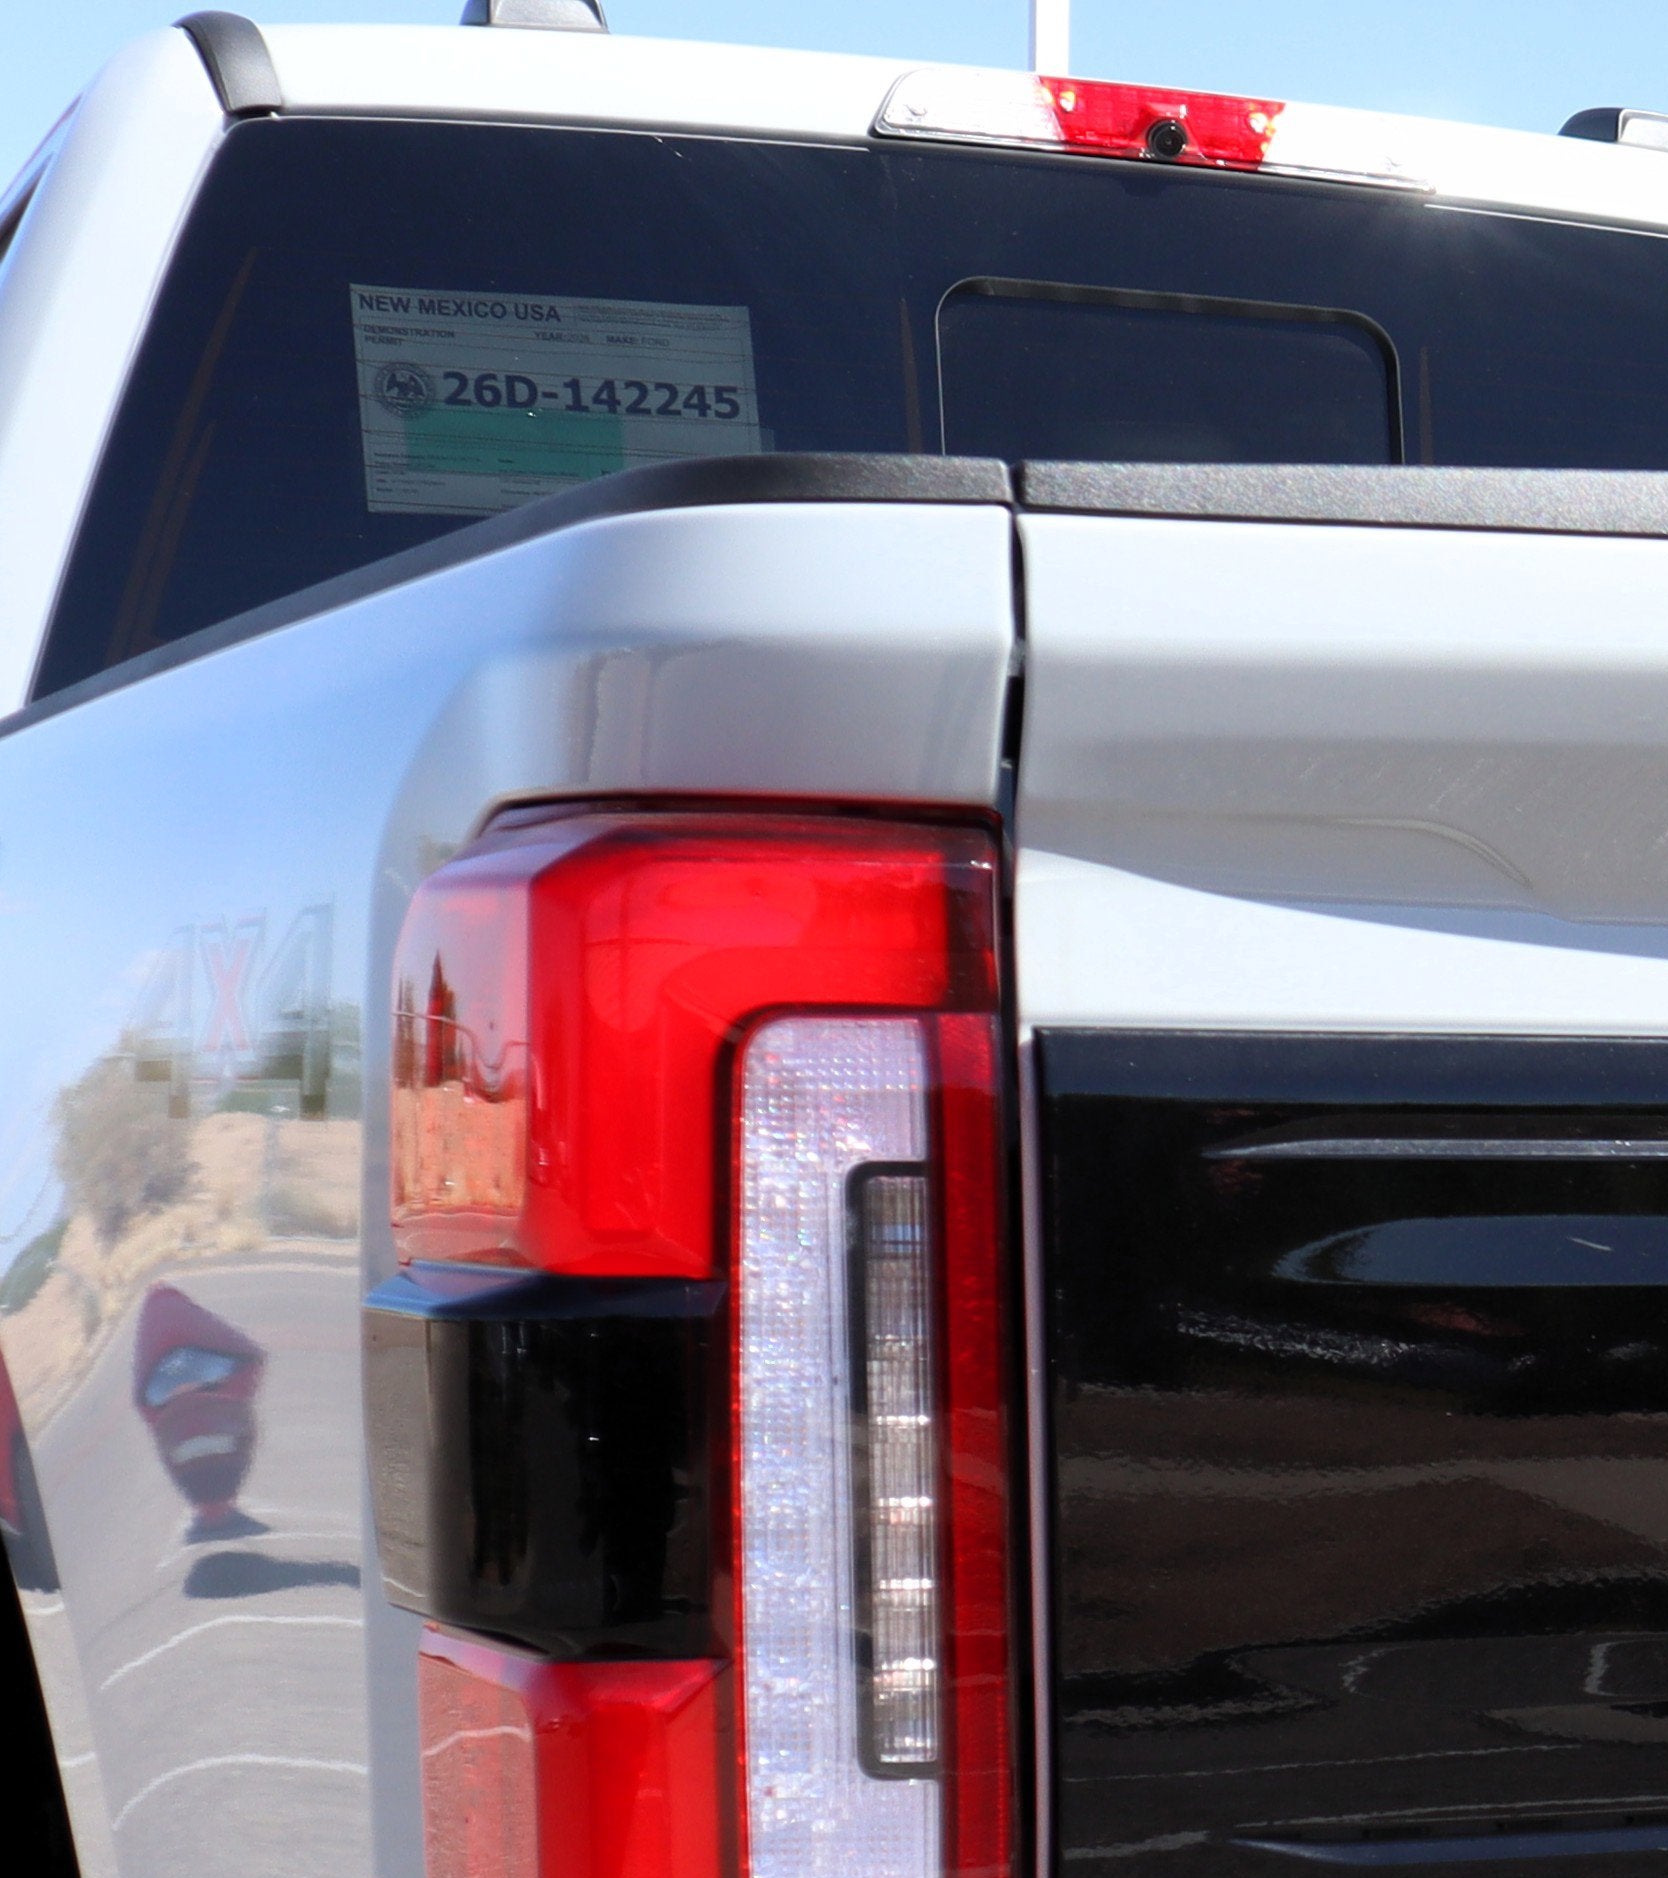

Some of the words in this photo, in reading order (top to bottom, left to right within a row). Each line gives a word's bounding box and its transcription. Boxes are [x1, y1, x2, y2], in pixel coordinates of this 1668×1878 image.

[359, 293, 411, 313] NEW
[418, 298, 507, 319] MEXICO
[514, 303, 561, 323] USA
[364, 324, 455, 339] DEMONSTRATION
[365, 334, 404, 347] PERMIT
[442, 370, 741, 420] 26D-142245
